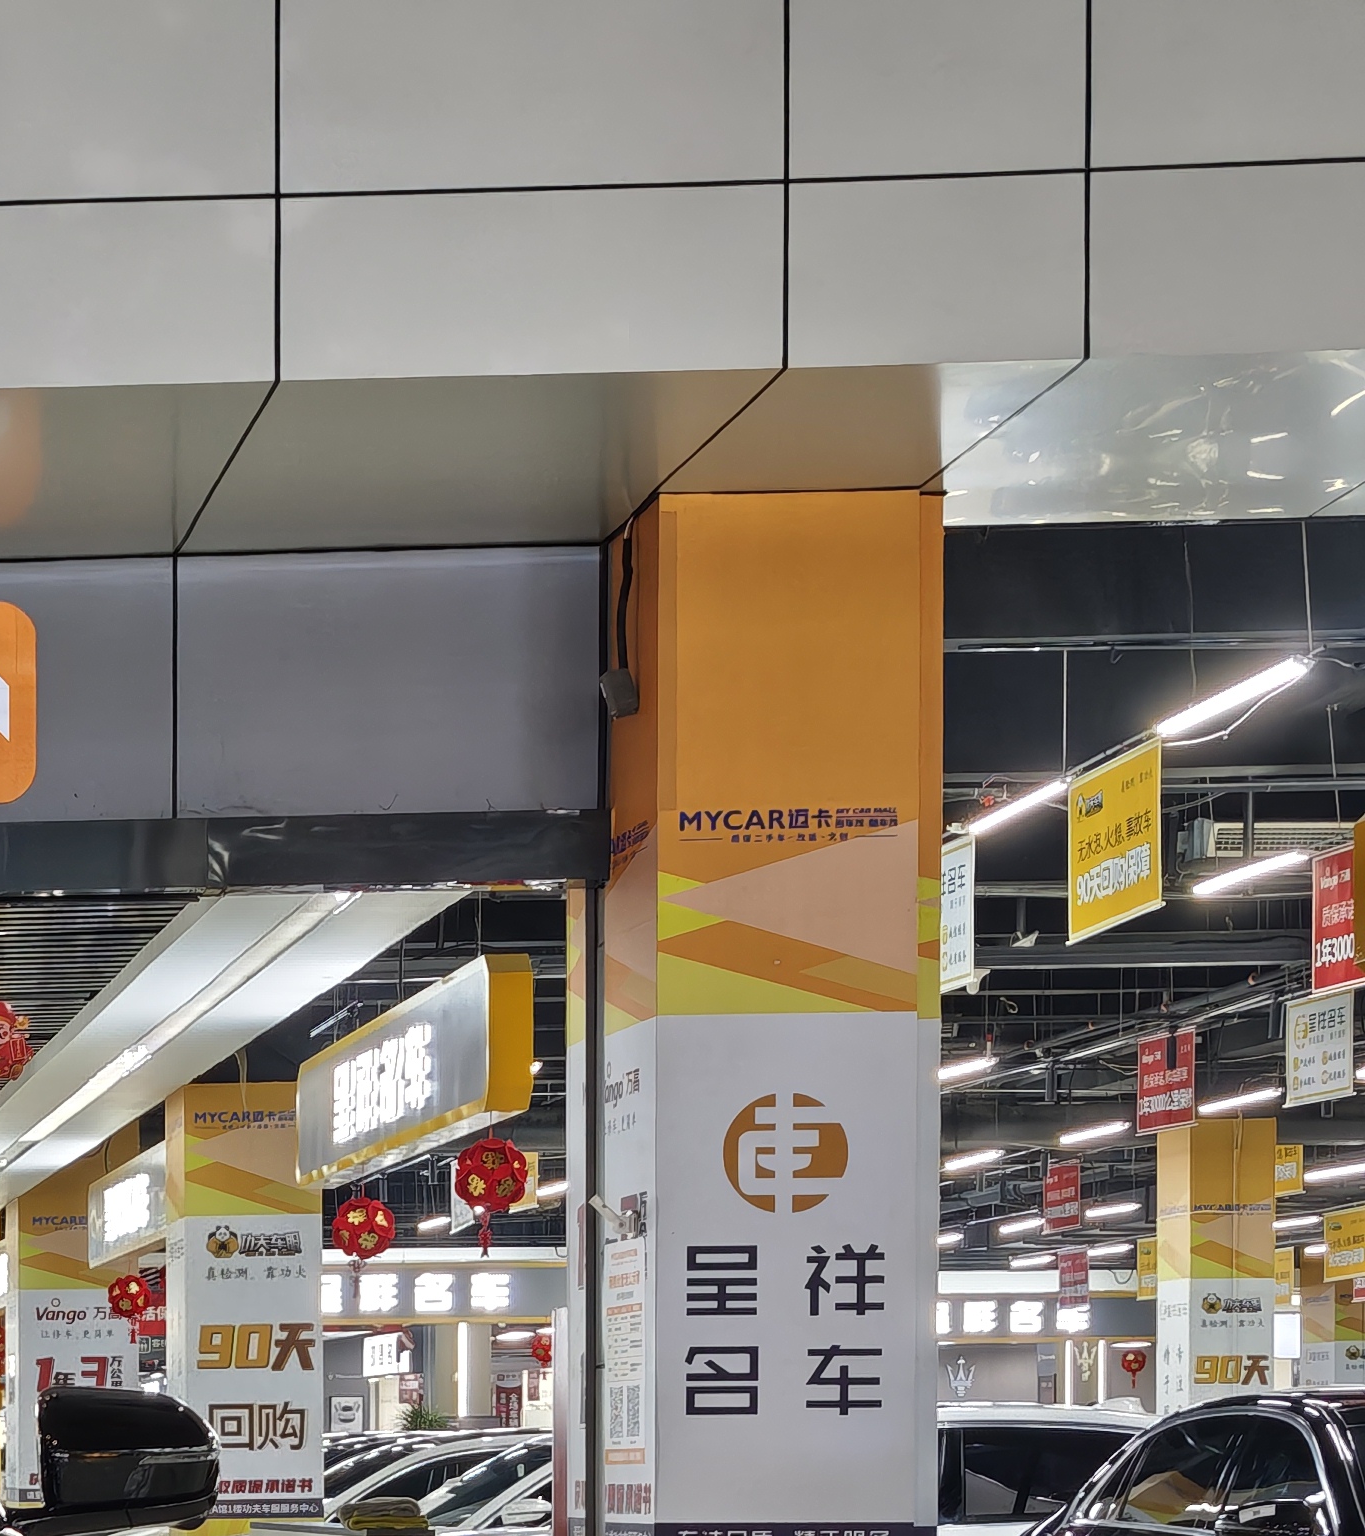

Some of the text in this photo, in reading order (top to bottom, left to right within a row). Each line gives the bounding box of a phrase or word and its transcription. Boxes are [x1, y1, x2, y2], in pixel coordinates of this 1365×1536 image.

[1076, 842, 1152, 906] 90天回购保障
[35, 1305, 87, 1325] Vango
[196, 1323, 316, 1372] 90天
[1193, 1354, 1270, 1386] 90天
[207, 1401, 309, 1451] 回购
